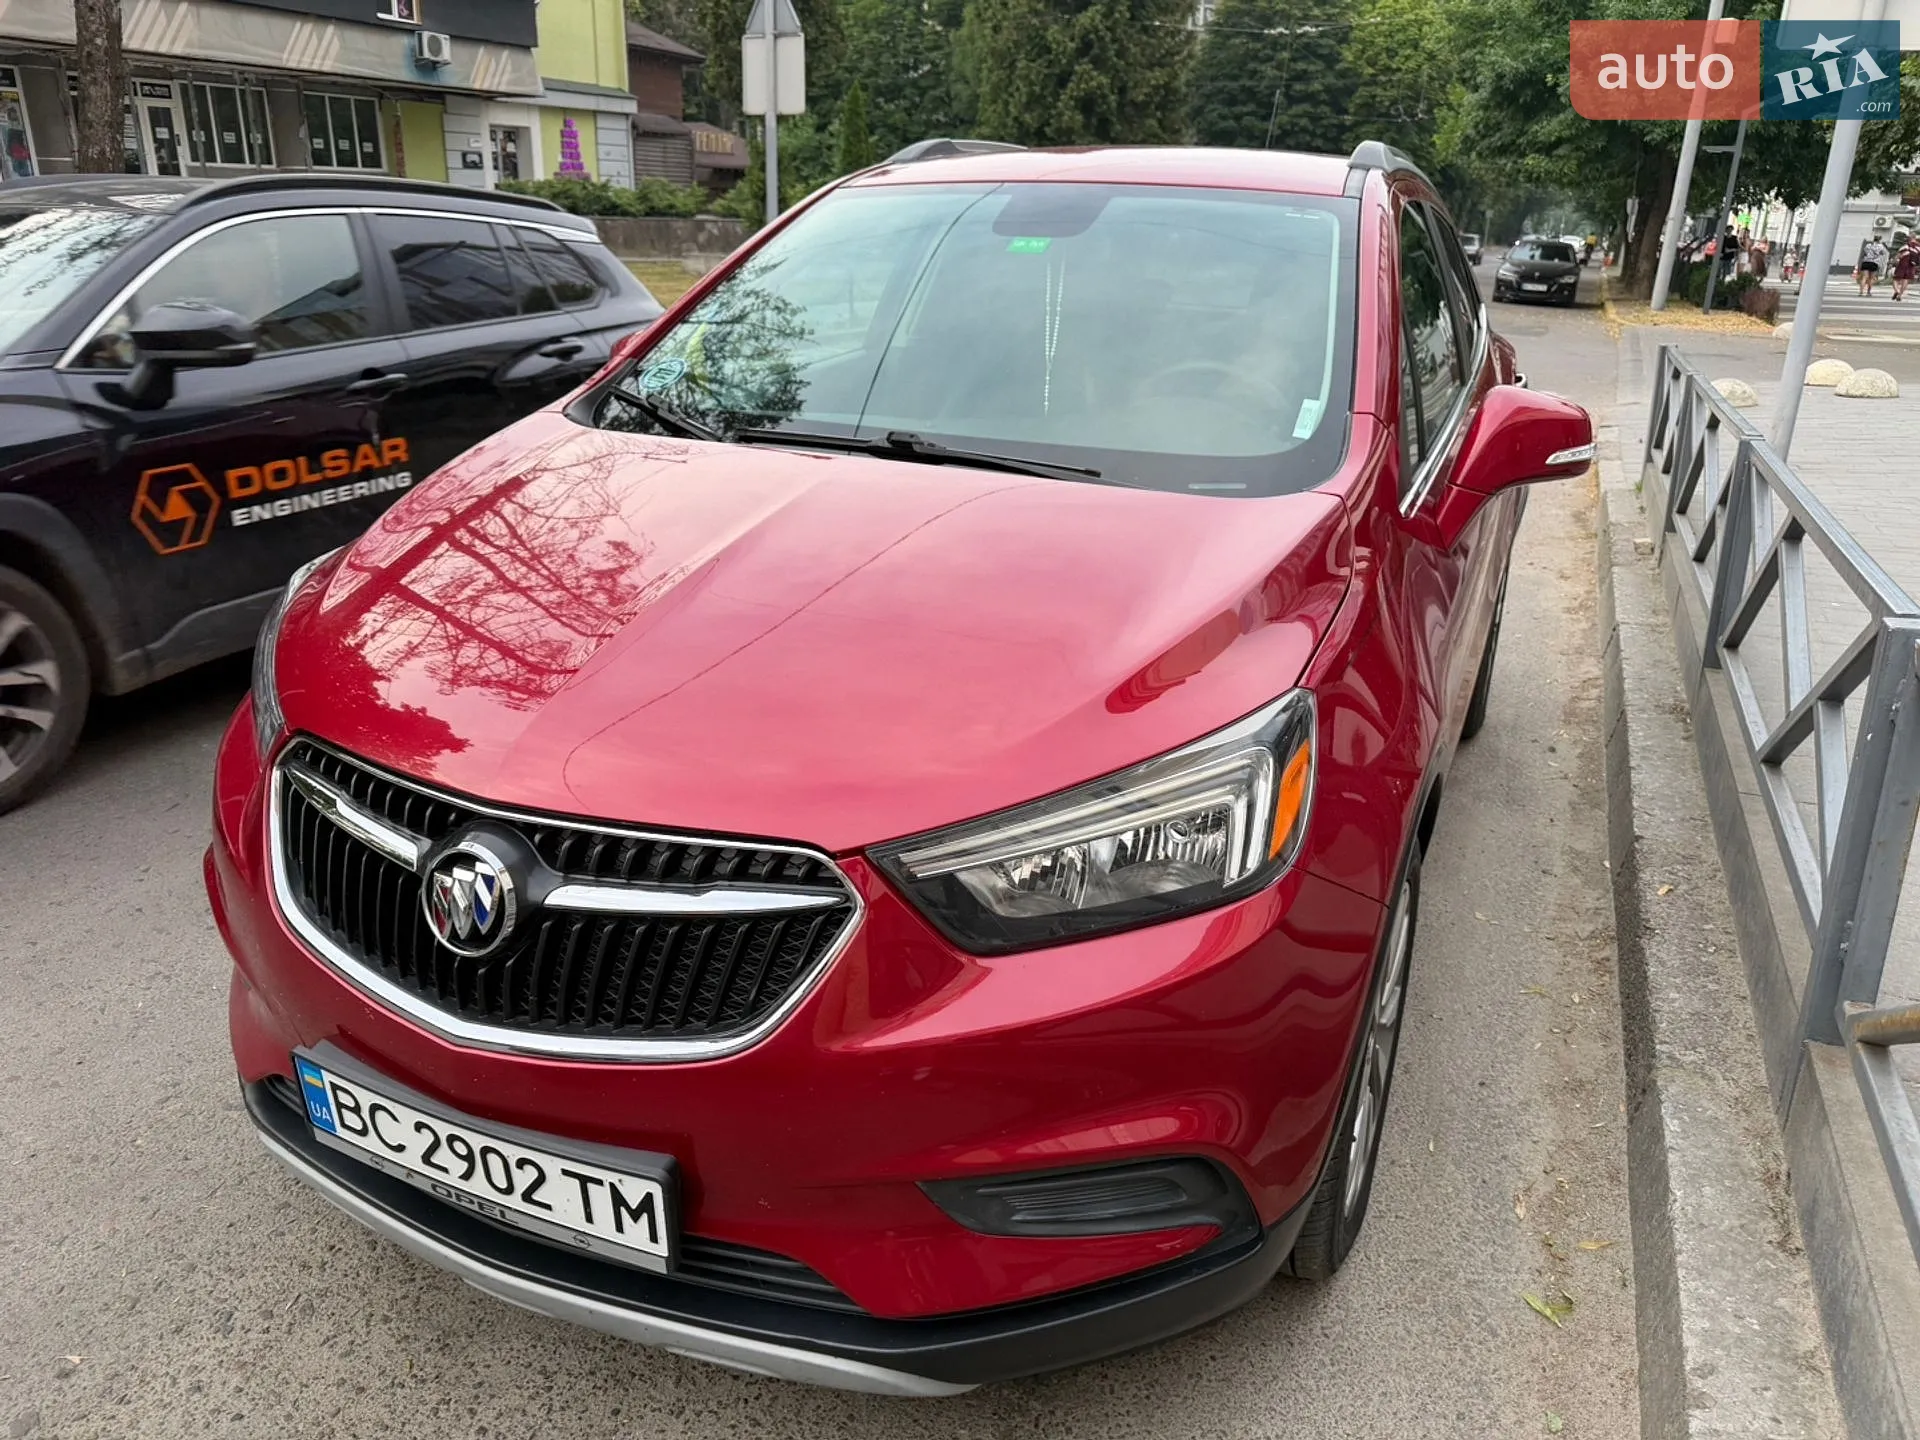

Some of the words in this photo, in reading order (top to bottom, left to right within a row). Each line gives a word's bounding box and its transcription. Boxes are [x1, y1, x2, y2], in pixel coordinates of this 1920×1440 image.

[224, 437, 410, 499] DOLSAR
[230, 471, 413, 527] ENGINEERING
[309, 1100, 333, 1124] UA
[328, 1079, 406, 1153] BC
[413, 1120, 552, 1212] 2902
[561, 1167, 660, 1245] TM
[430, 1182, 519, 1225] OPEL
